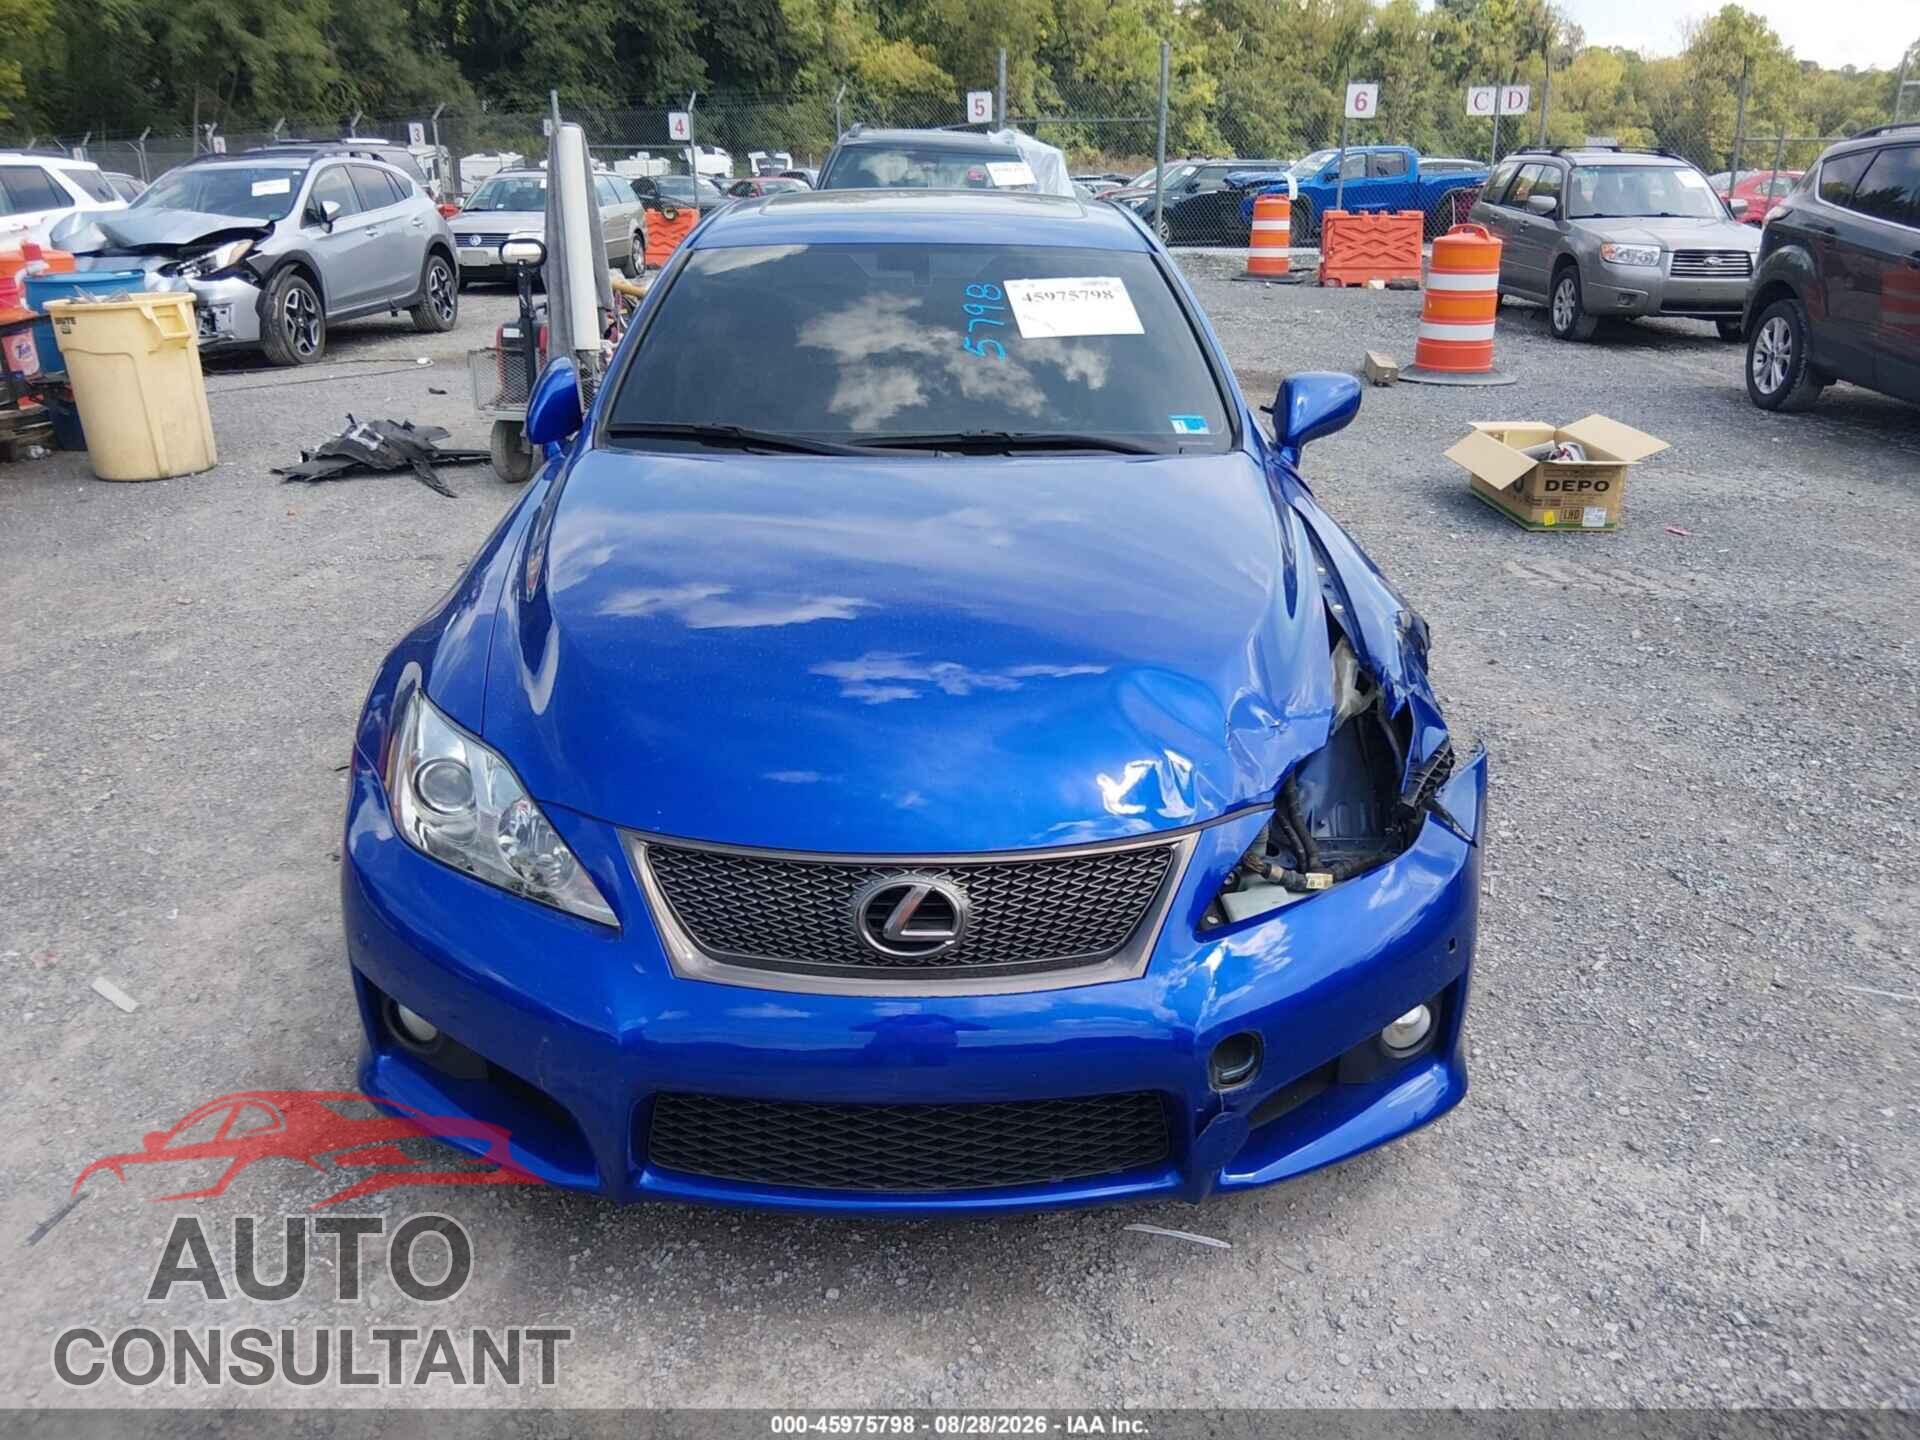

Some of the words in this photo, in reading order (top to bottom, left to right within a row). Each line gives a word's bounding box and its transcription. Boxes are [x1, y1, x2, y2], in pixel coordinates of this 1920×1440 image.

[974, 98, 985, 117] 5
[1354, 91, 1368, 112] 6
[1473, 91, 1489, 111] C
[1508, 91, 1524, 109] D
[674, 118, 685, 135] 4
[1022, 289, 1115, 303] 45975798
[962, 283, 1006, 361] 5798
[1544, 479, 1610, 492] DEPO
